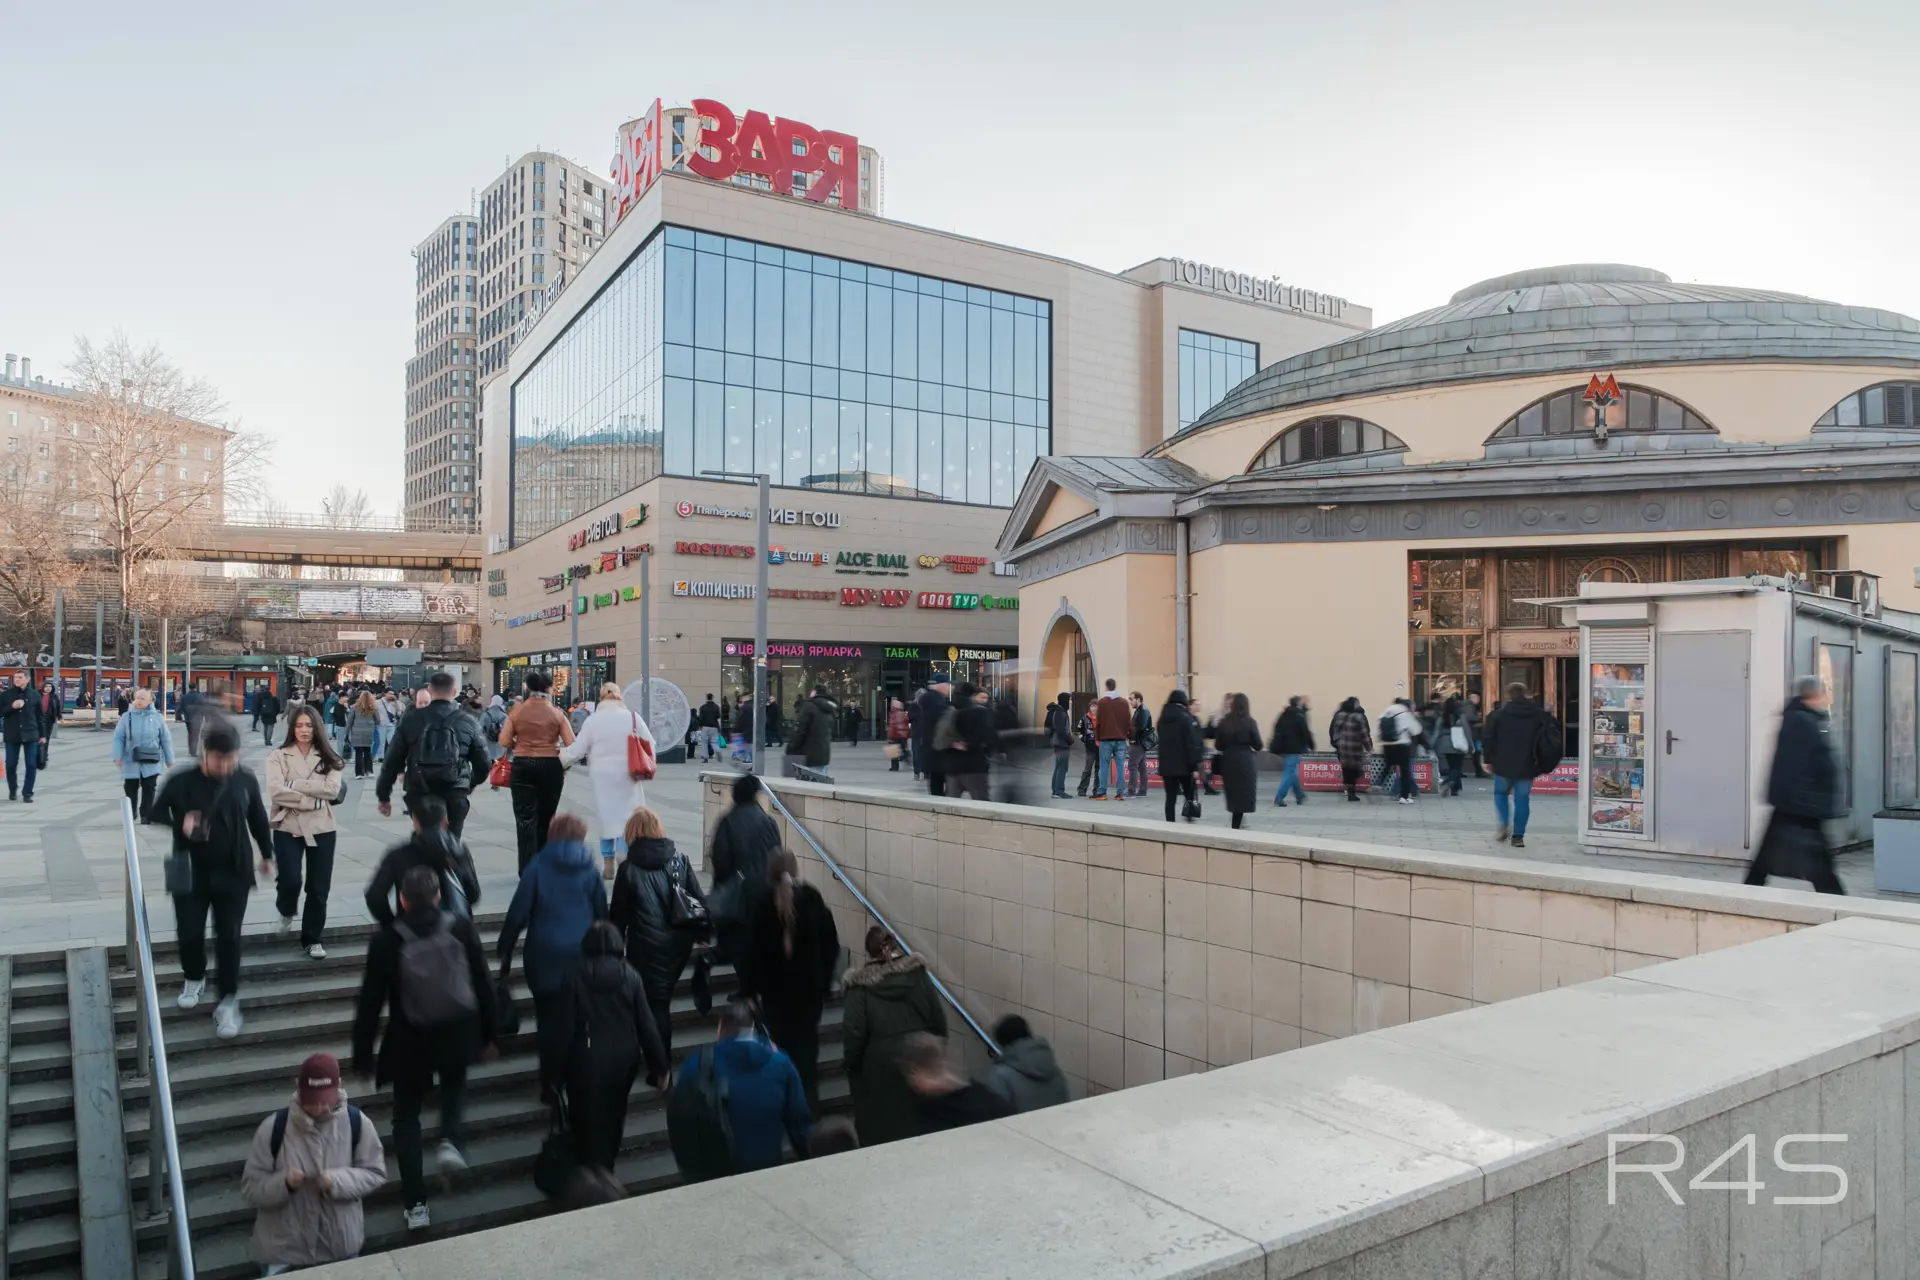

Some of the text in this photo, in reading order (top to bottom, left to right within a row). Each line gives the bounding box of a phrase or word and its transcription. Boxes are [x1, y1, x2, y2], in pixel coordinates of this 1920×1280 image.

[686, 98, 858, 209] ЗАРЯ
[609, 97, 662, 231] ЗАРЯ
[1171, 257, 1349, 319] ТОРГОВЫЙ ЦЕНТР
[768, 507, 841, 527] ИВ ГОШ
[836, 551, 910, 569] ALOE NAIL
[943, 555, 989, 566] СМЕШНЫЕ
[953, 565, 980, 573] ЦЕНЫ
[738, 644, 805, 656] ЦВОЧНАЯ
[808, 646, 862, 657] ЯРМАРКА
[885, 647, 919, 658] ТАБАК
[959, 649, 1002, 660] FRENCH BAKERY
